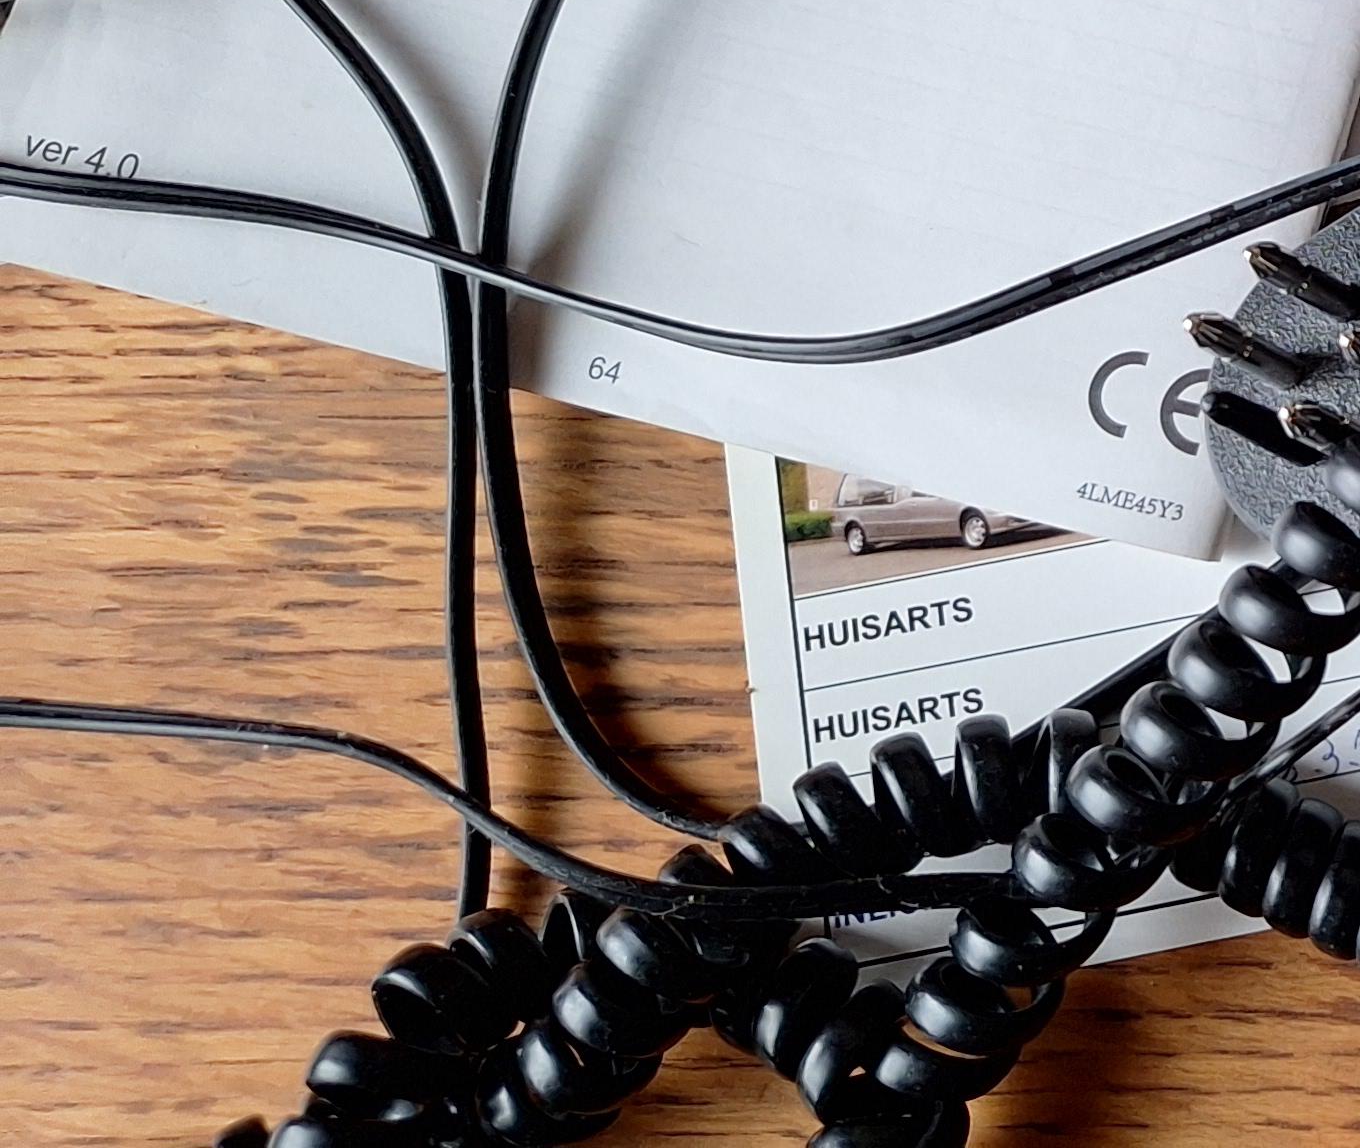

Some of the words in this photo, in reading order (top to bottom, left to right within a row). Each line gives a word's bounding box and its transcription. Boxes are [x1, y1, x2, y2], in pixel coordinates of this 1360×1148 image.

[25, 135, 78, 165] ver
[85, 146, 140, 179] 4.0
[588, 357, 621, 383] 64
[1075, 481, 1185, 521] 4LME45Y3
[803, 597, 974, 652] HUISARTS
[812, 687, 984, 744] HUISARTS
